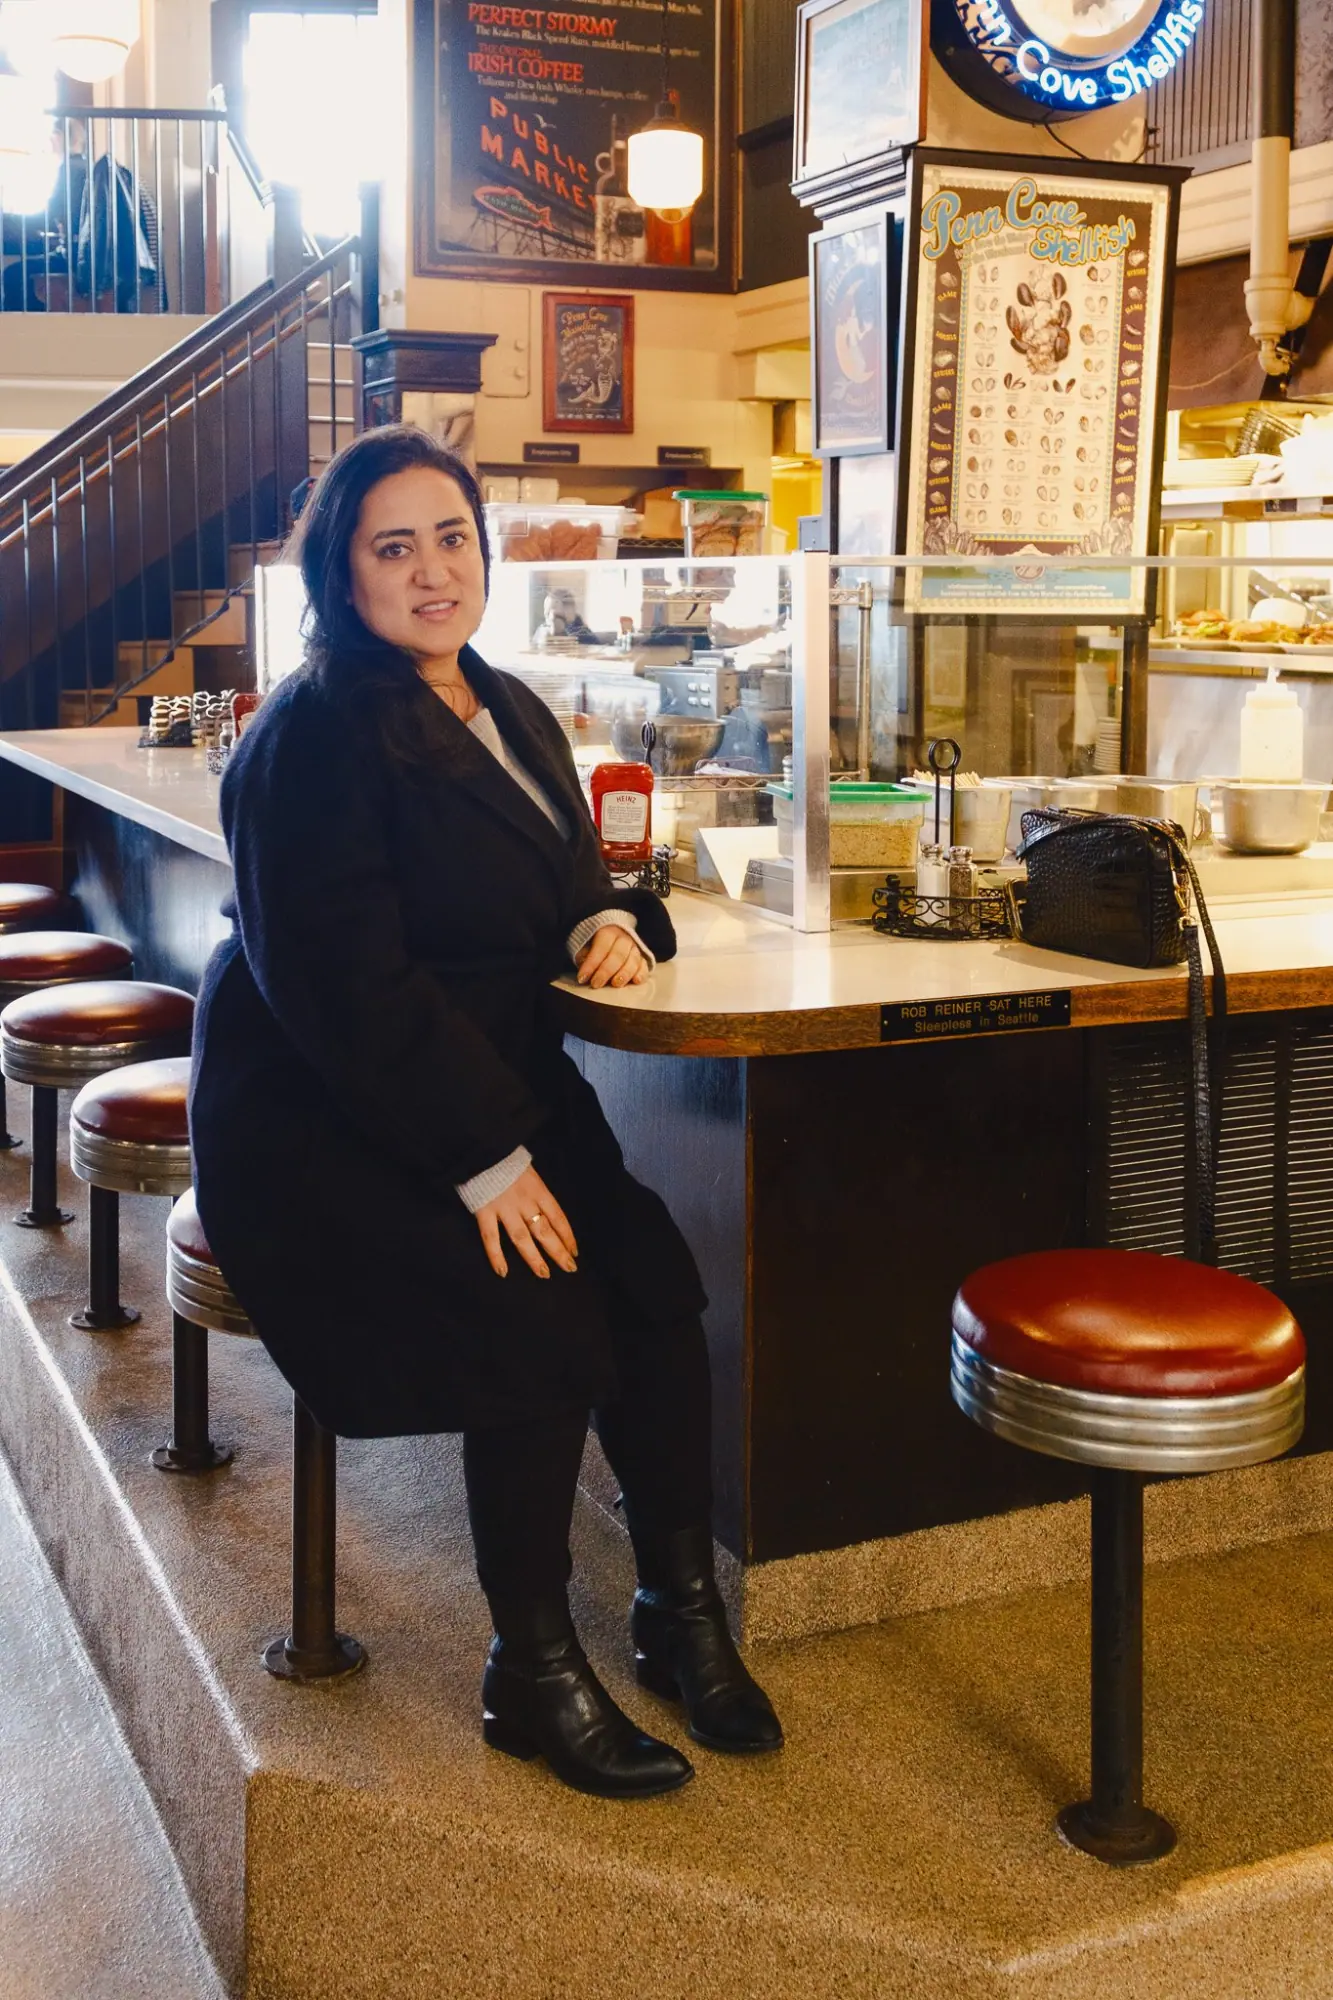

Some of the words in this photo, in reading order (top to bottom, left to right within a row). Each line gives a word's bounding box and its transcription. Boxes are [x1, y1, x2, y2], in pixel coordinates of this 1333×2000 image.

[468, 2, 545, 29] PERFECT
[546, 11, 617, 38] STORMY
[475, 24, 490, 35] The
[468, 52, 514, 76] IRISH
[517, 58, 584, 82] COFFEE
[1016, 39, 1098, 104] Cove
[1106, 0, 1204, 101] Shellfis
[489, 96, 589, 184] PUBLIC
[921, 190, 1004, 260] Penn
[1006, 177, 1087, 230] Cove
[1030, 215, 1136, 266] Shellfish
[616, 796, 636, 804] HEINZ
[901, 1006, 927, 1019] ROB
[935, 1002, 982, 1015] REINER
[989, 999, 1011, 1012] SAT
[1019, 995, 1052, 1009] HERE
[915, 1019, 972, 1034] Sleepless
[980, 1016, 990, 1027] in
[998, 1012, 1039, 1026] Seattle
